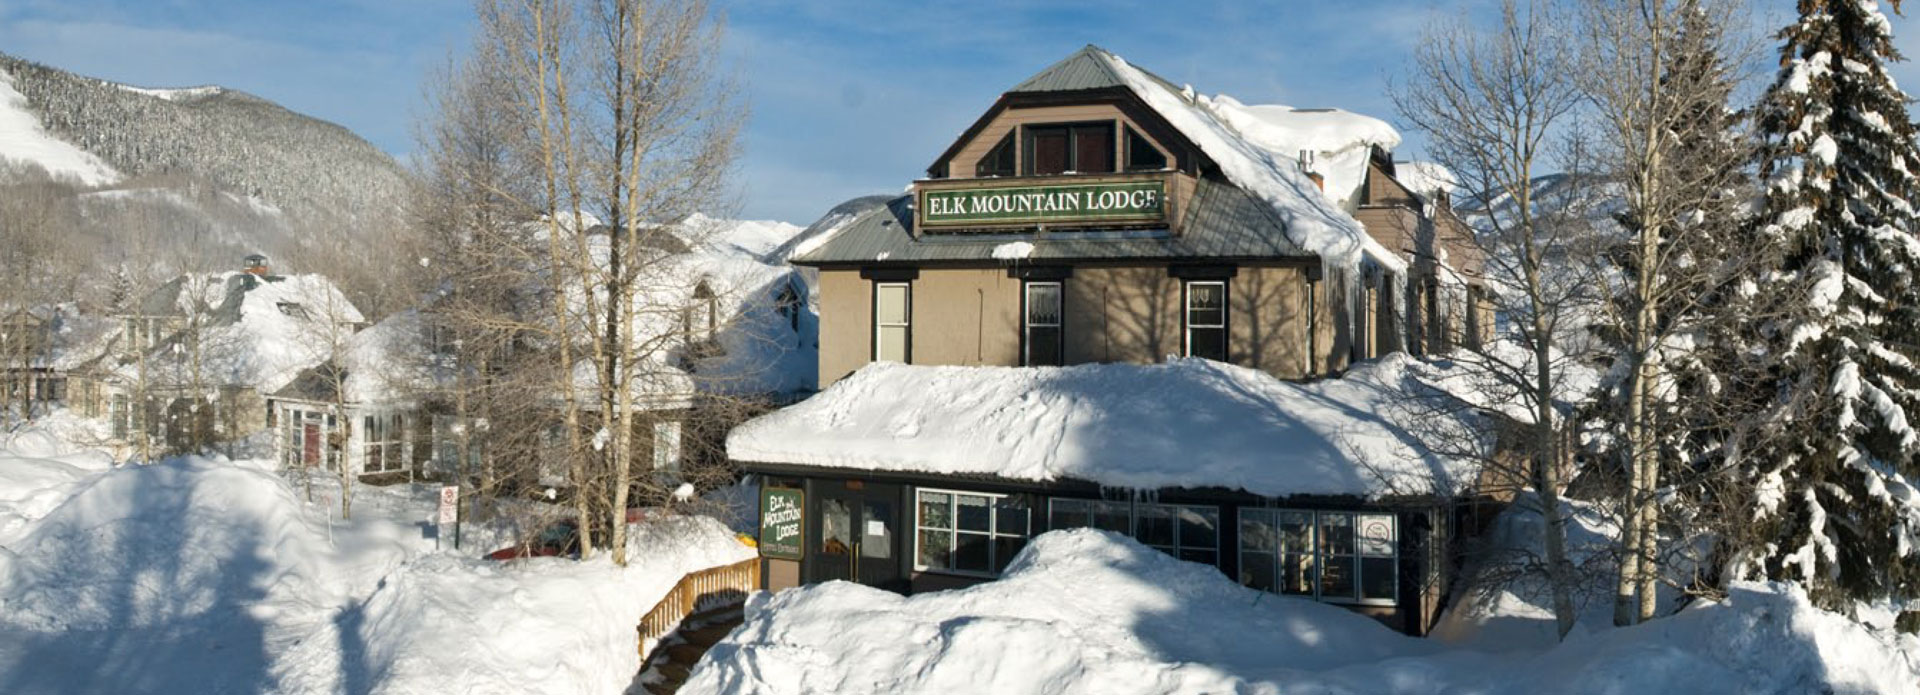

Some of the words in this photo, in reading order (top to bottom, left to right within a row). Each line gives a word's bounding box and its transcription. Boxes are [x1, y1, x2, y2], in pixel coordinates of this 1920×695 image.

[930, 196, 968, 216] ELK
[970, 191, 1080, 215] MOUNTAIN
[1086, 189, 1158, 210] LODGE
[770, 495, 785, 512] ELK
[763, 508, 801, 528] MOUNTAIN
[776, 523, 800, 541] LODGE
